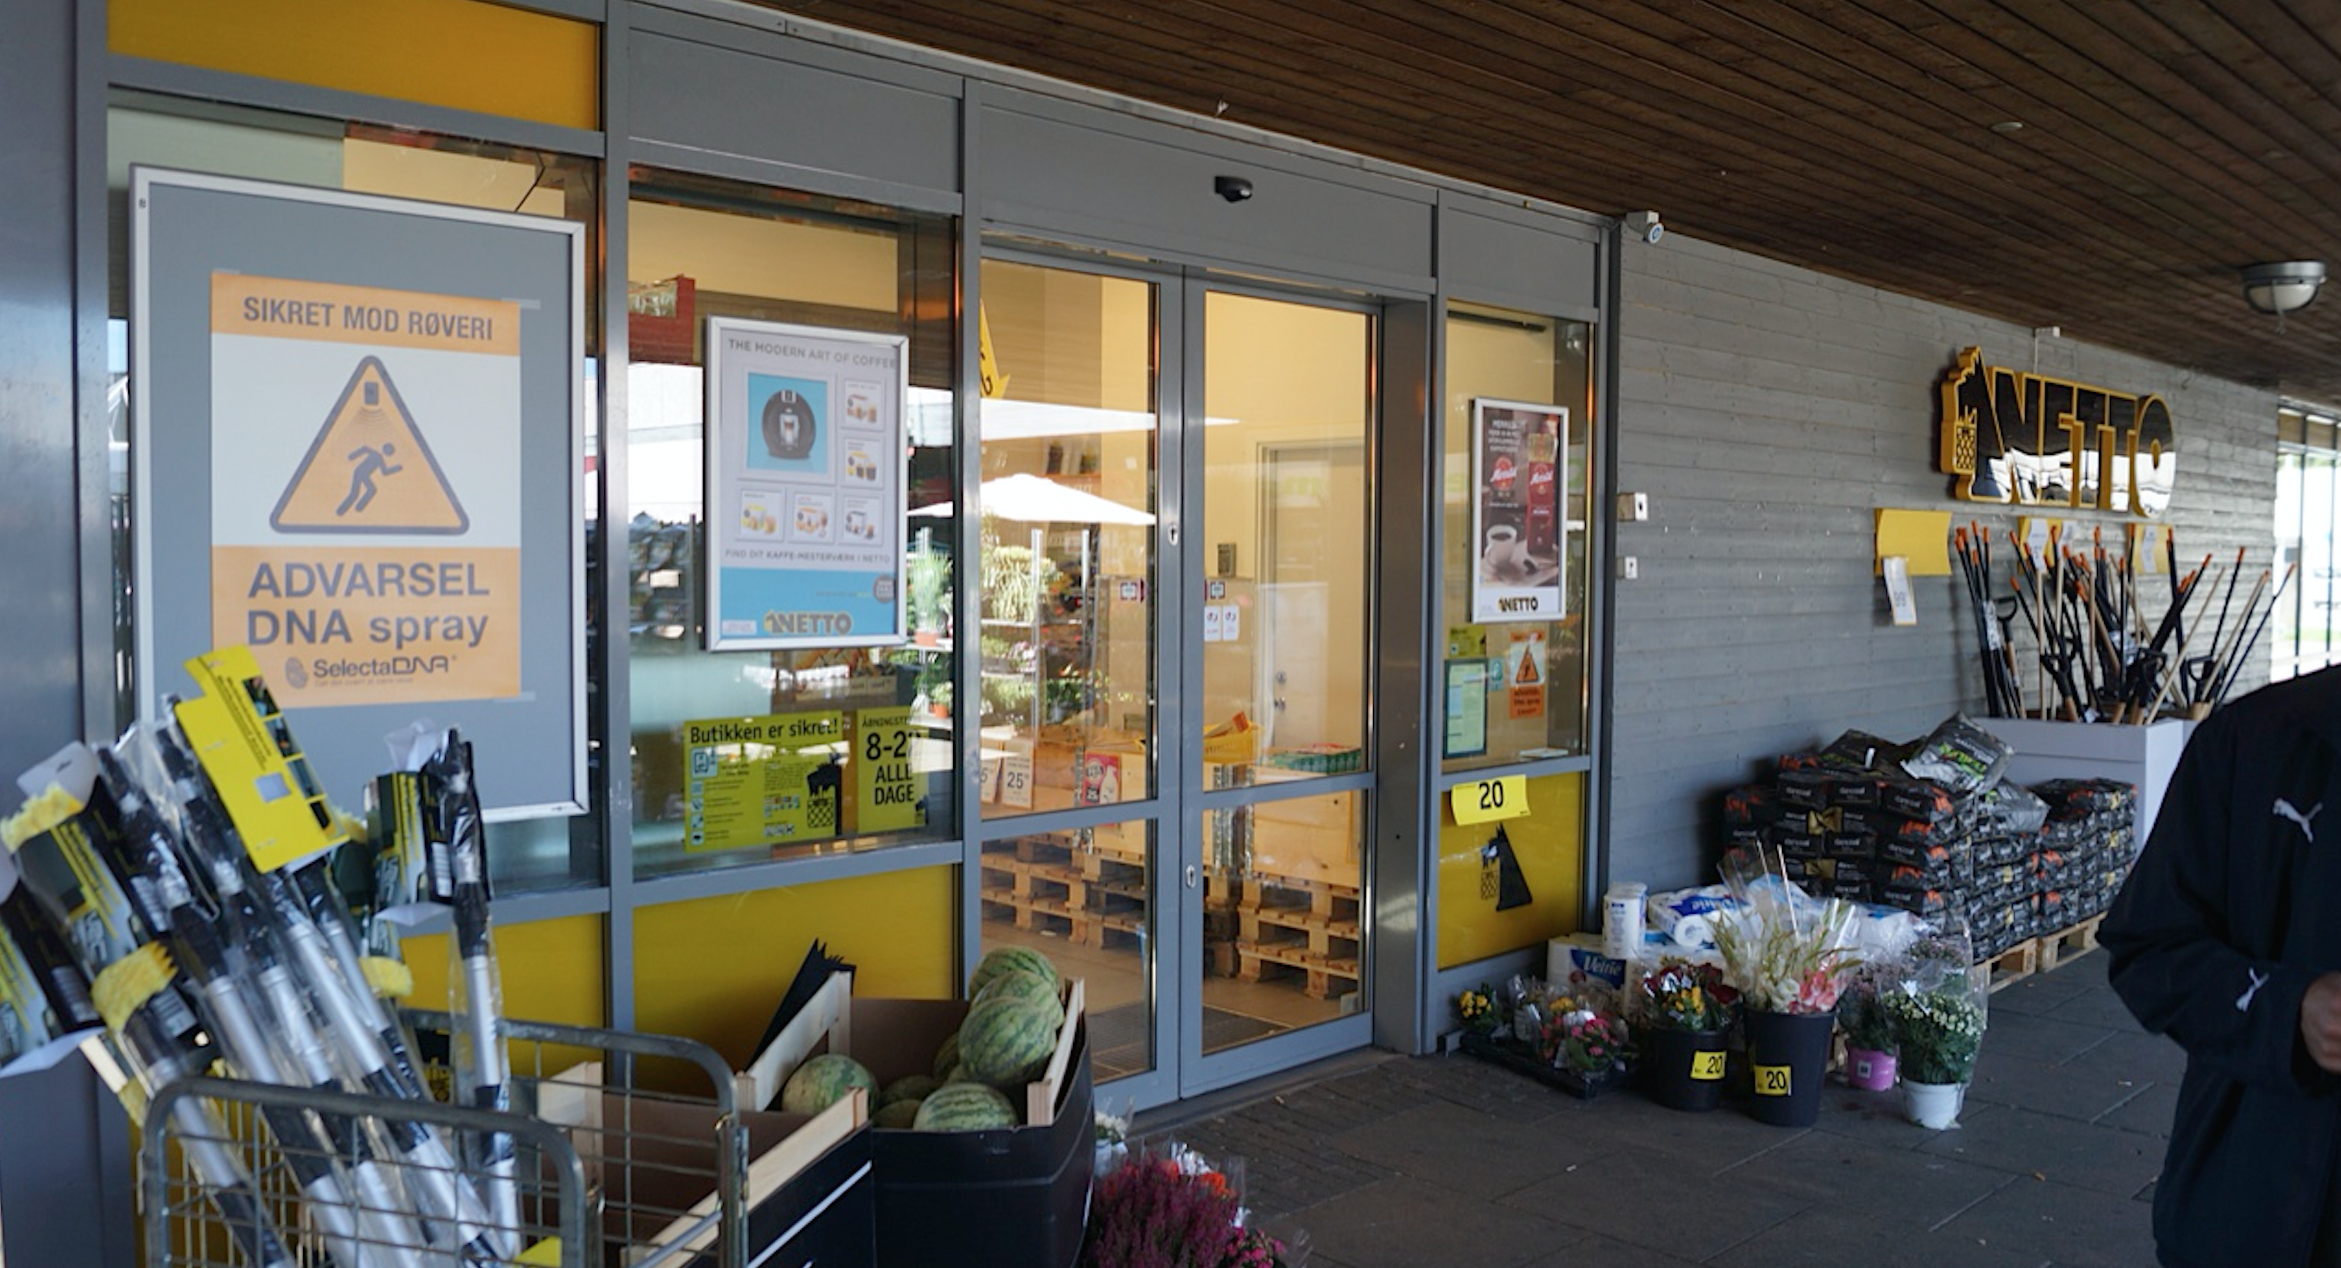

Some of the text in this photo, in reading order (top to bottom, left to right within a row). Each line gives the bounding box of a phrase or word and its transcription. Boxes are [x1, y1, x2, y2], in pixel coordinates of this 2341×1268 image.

[243, 296, 493, 341] SIKRET MOD RØVERI
[729, 338, 898, 369] THE MODERN ART OF COFFEE
[1941, 346, 2177, 518] NETTO
[862, 555, 891, 563] NETTO
[248, 562, 490, 598] ADVARSEL
[1498, 595, 1539, 612] NETTO
[248, 608, 489, 649] DNA spray
[765, 610, 852, 635] NETTO
[313, 655, 448, 678] SelectaDNA
[690, 723, 762, 744] Butikken
[768, 725, 784, 738] er
[866, 730, 921, 761] 8-2
[875, 784, 915, 806] DAGE
[1479, 781, 1504, 810] 20
[1706, 1056, 1723, 1074] 20
[1766, 1070, 1787, 1090] 20
